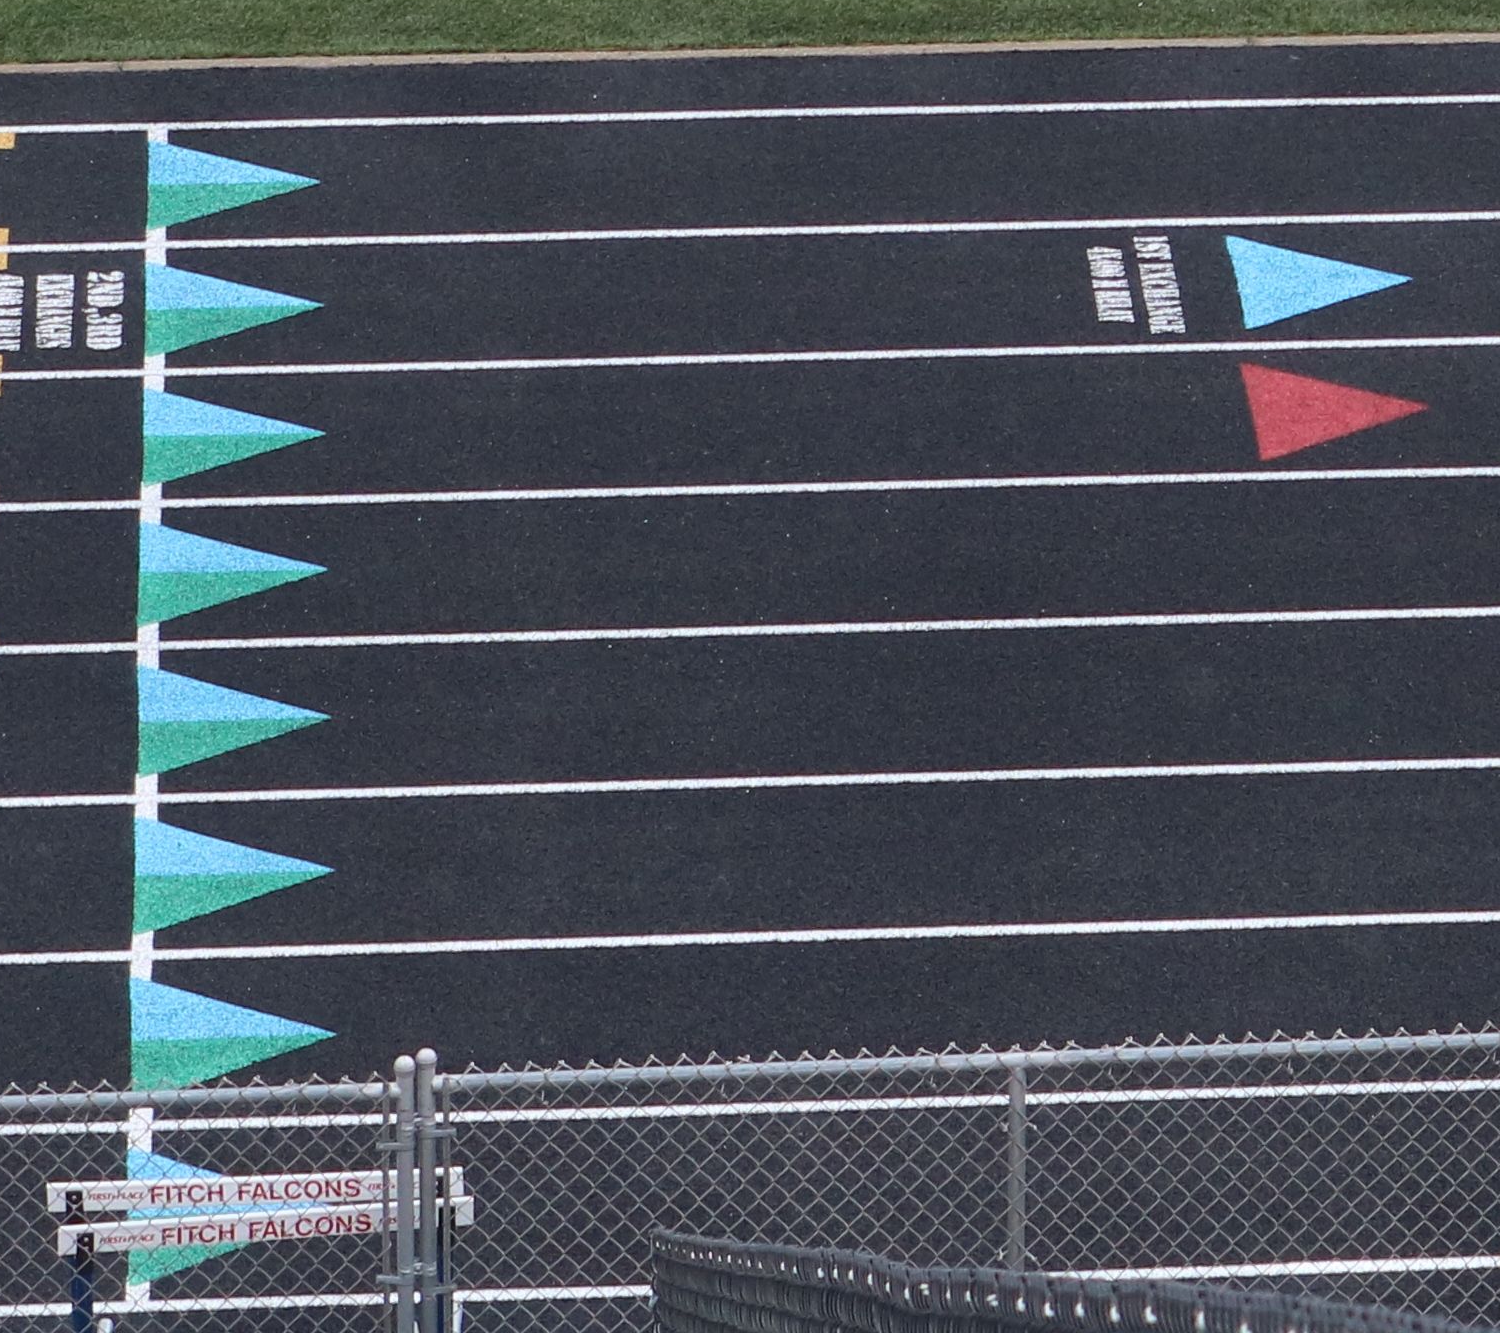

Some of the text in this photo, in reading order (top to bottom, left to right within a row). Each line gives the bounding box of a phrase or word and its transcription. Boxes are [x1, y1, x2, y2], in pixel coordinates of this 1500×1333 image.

[1133, 236, 1186, 334] 1ST EXCHANGE
[35, 273, 75, 349] EXCHANGES
[1094, 290, 1135, 323] RELAY
[148, 1184, 224, 1205] FITCH
[238, 1178, 361, 1202] FALCONS
[161, 1223, 235, 1246] FITCH
[249, 1213, 372, 1240] FALCONS
